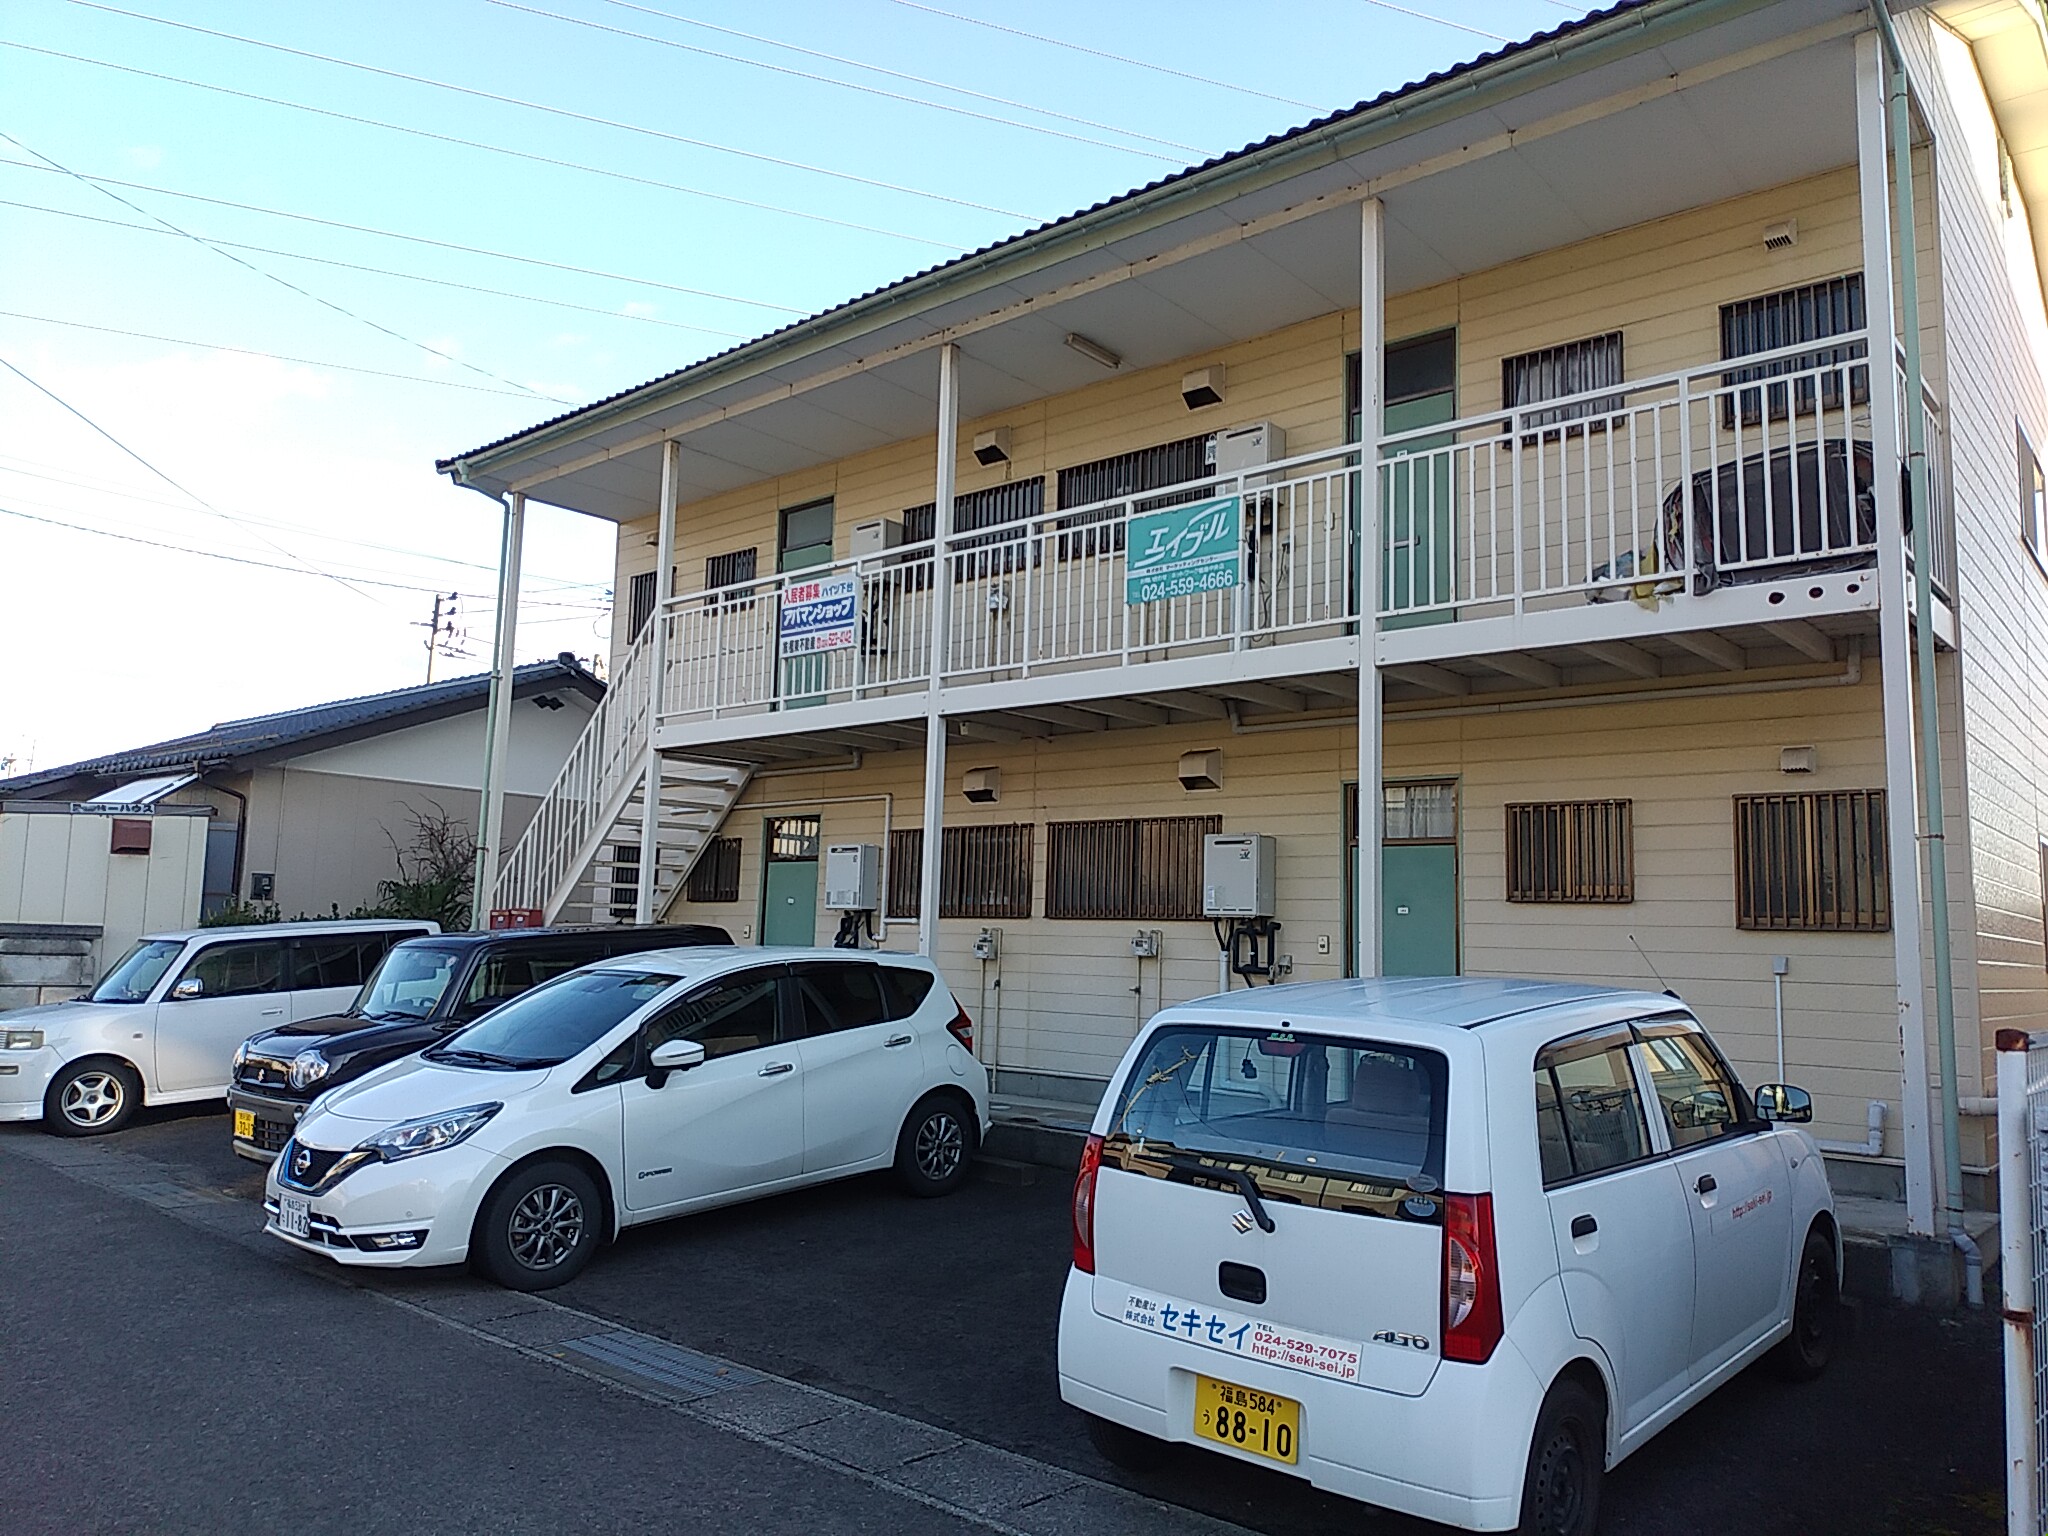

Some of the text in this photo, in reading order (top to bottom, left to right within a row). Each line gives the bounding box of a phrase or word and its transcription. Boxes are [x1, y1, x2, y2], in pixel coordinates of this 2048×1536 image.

[1138, 506, 1231, 562] エイブル
[784, 583, 820, 605] 入居者募集
[1141, 569, 1233, 602] 024-559-4666
[783, 597, 853, 627] アパマンショップ
[286, 1209, 308, 1235] 11-82
[1128, 1294, 1157, 1312] 不動産は
[1124, 1309, 1156, 1328] 株式会社
[1159, 1302, 1252, 1351] セキセイ
[1256, 1322, 1275, 1334] TEL
[1253, 1331, 1358, 1365] 024-529-7075
[1371, 1329, 1430, 1351] ALTO
[1251, 1342, 1356, 1379] http://seki-sei.jp
[1214, 1405, 1293, 1458] 88-10
